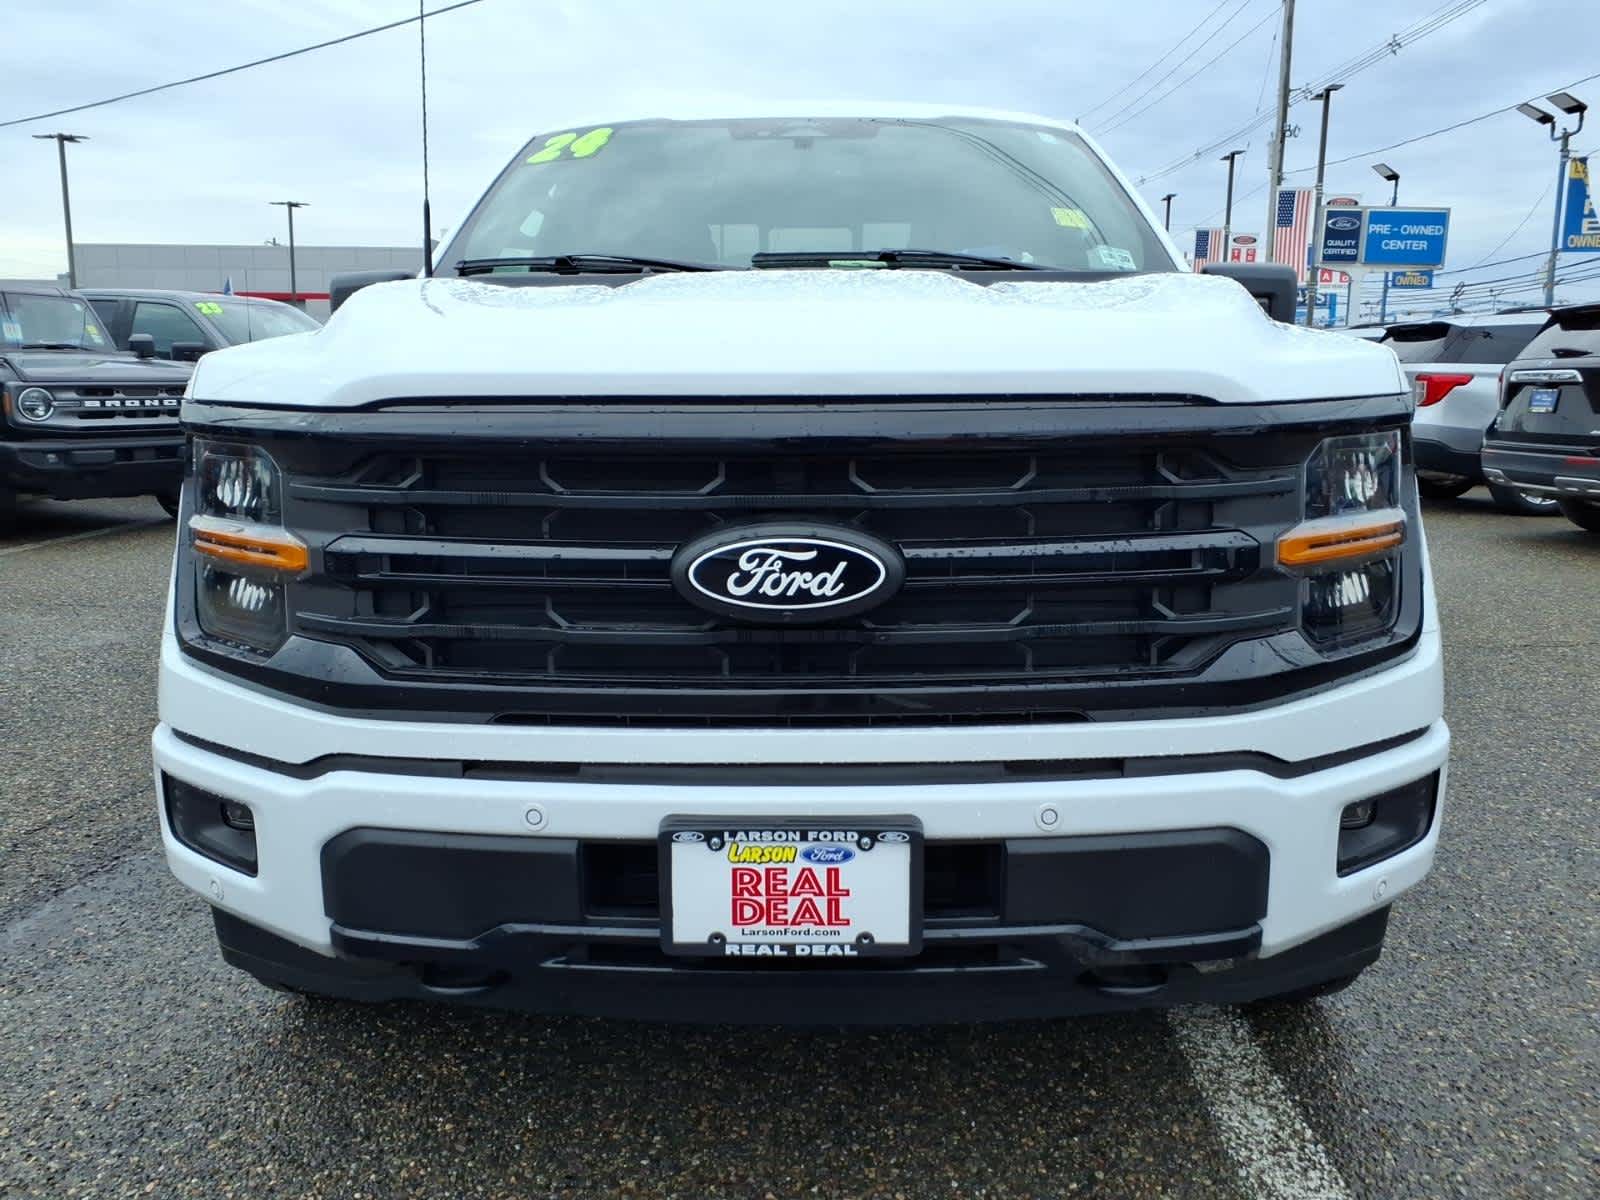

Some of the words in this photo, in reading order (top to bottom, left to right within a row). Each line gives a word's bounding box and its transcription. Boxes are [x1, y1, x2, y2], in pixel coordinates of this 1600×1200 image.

[1326, 239, 1356, 247] QUALITY
[1381, 239, 1428, 251] CENTER
[726, 547, 848, 597] Ford
[723, 831, 799, 842] LARSON
[807, 831, 858, 842] FORD
[727, 842, 797, 864] LARSON
[731, 867, 850, 897] REAL
[731, 897, 850, 926] DEAL
[741, 928, 841, 936] LarsonFord.com
[725, 943, 788, 956] REAL
[795, 943, 859, 956] DEAL
